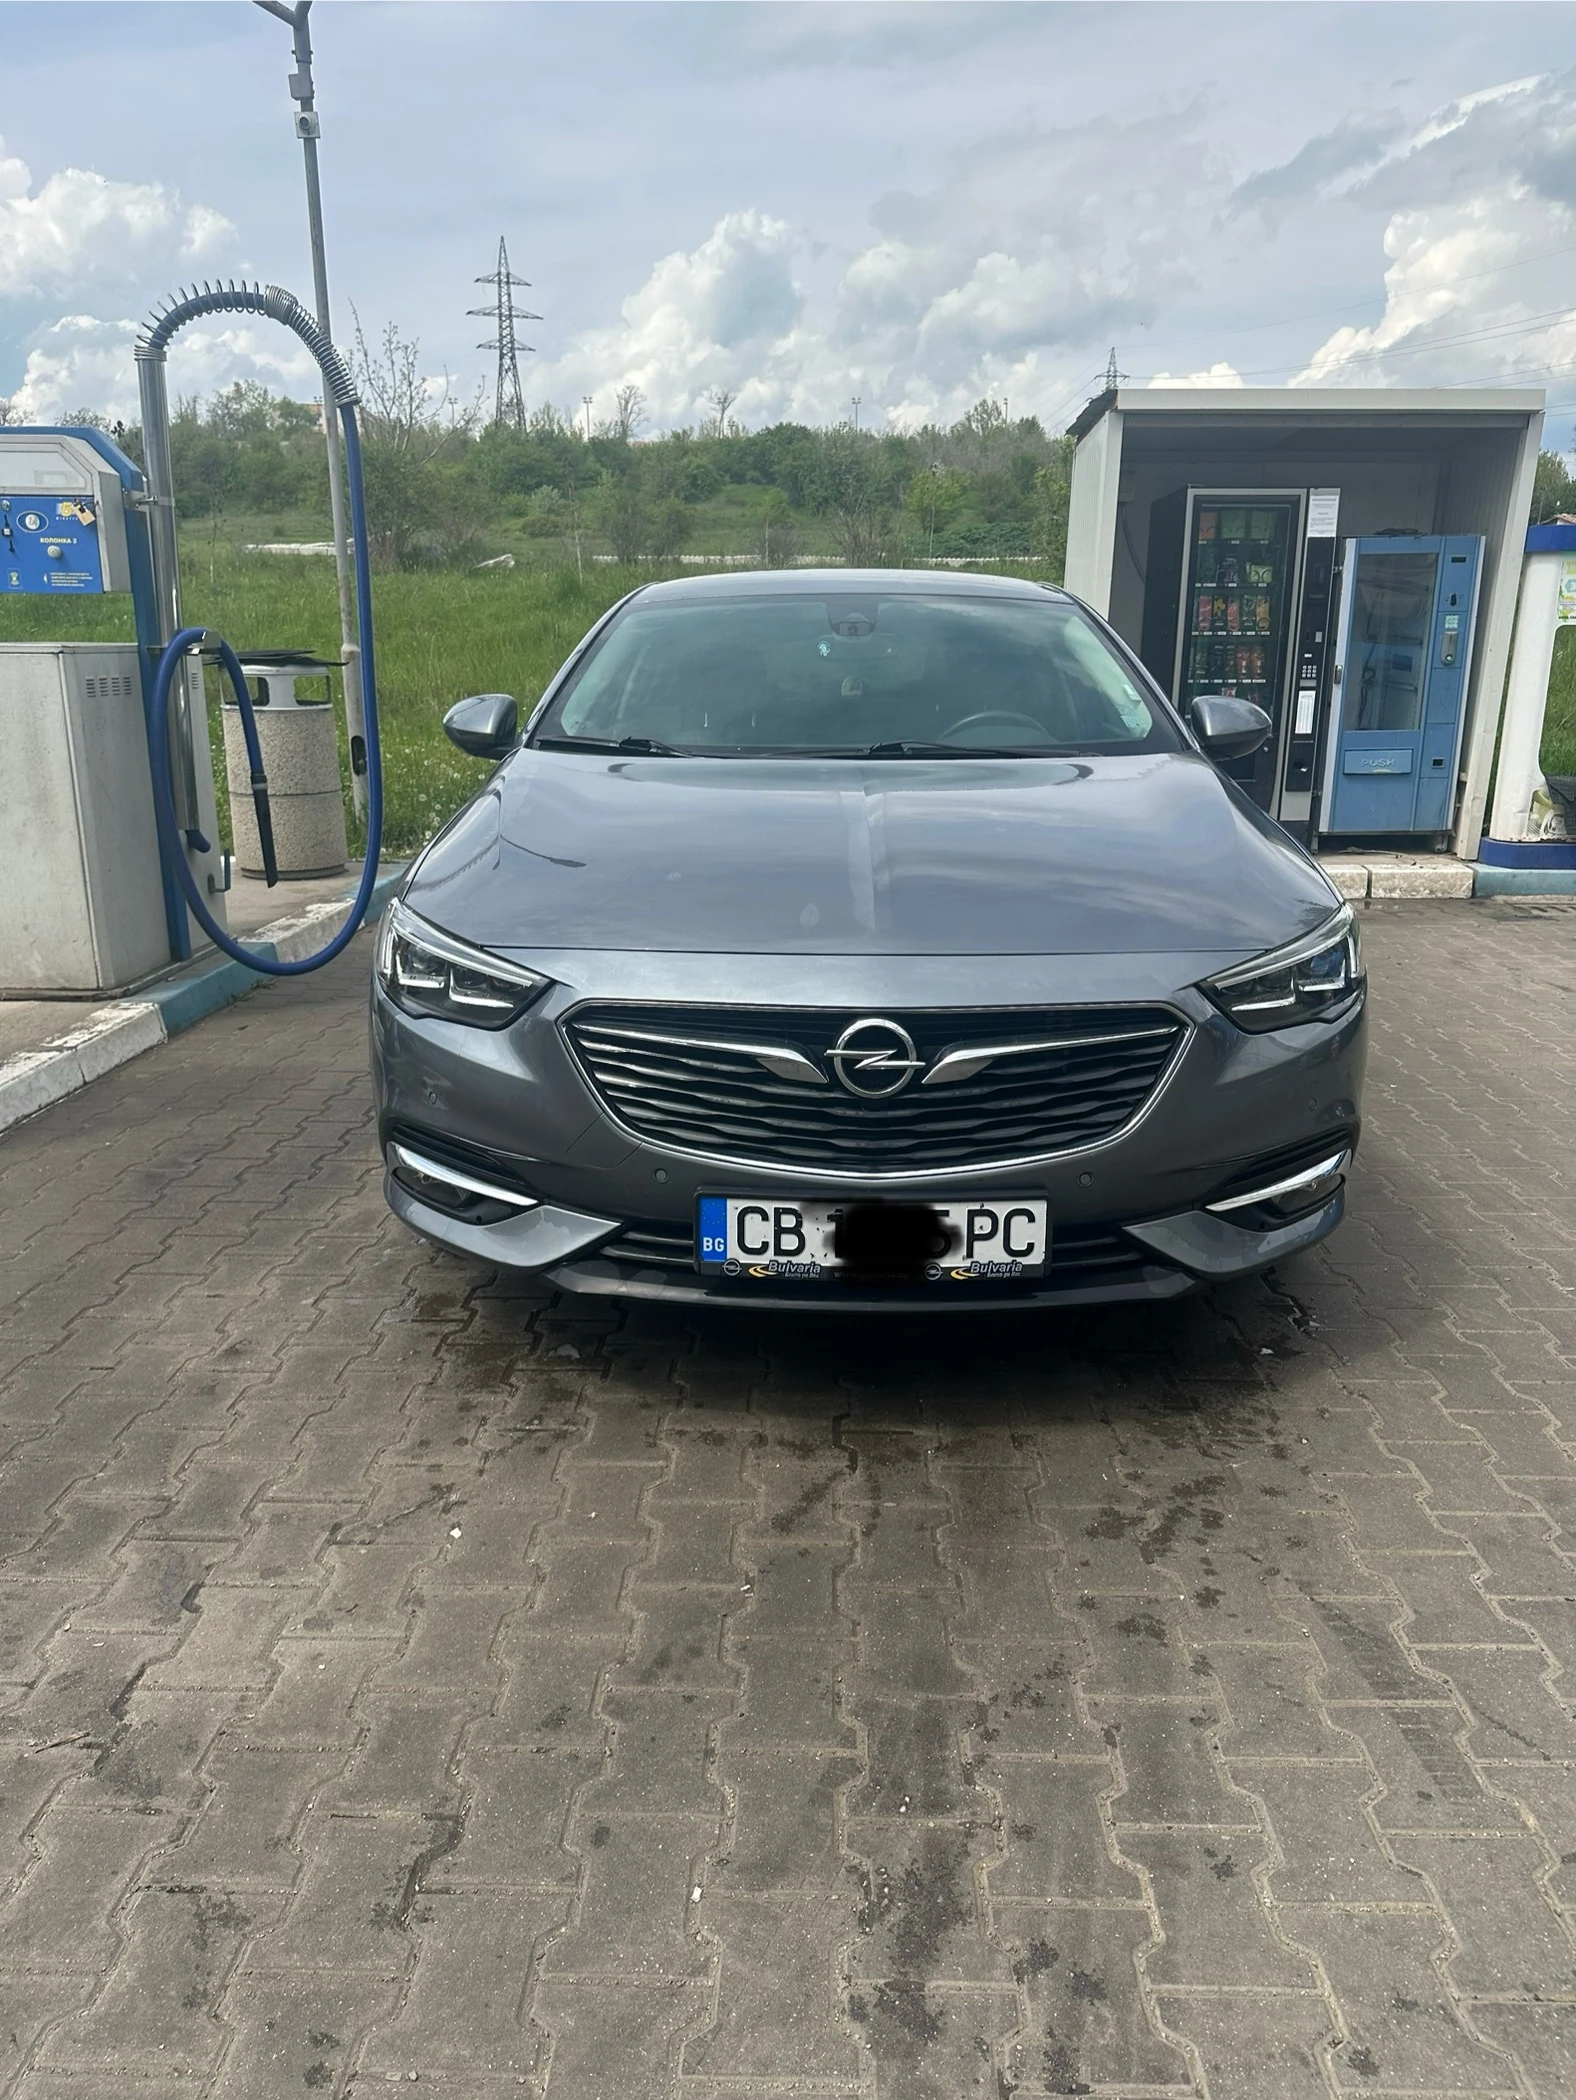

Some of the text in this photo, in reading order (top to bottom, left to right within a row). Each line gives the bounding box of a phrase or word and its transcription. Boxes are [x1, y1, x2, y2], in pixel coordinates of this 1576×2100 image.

[1361, 758, 1396, 768] PUSH
[703, 1237, 725, 1252] BG
[768, 1261, 821, 1274] Bulvaria
[970, 1261, 1023, 1274] Bulvaria
